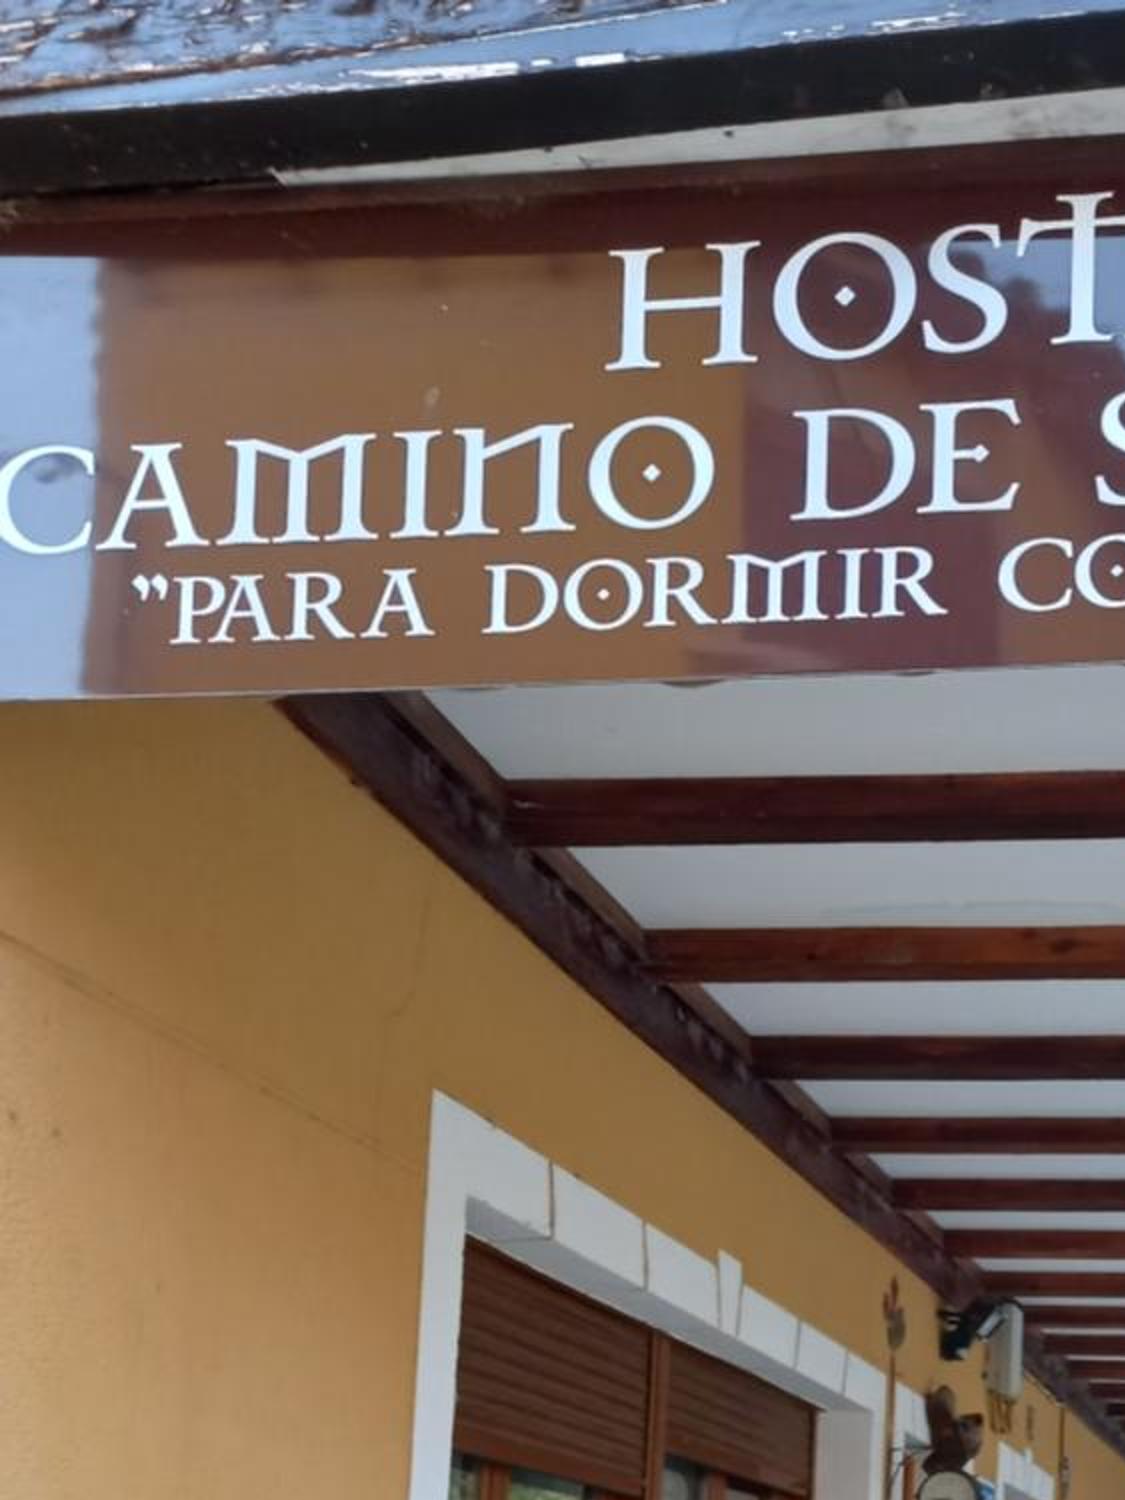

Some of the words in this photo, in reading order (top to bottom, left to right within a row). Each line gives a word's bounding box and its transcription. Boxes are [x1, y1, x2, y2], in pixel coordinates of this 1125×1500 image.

[0, 414, 715, 554] CAMINO
[790, 398, 1021, 521] DE
[483, 546, 948, 634] DORMIR
